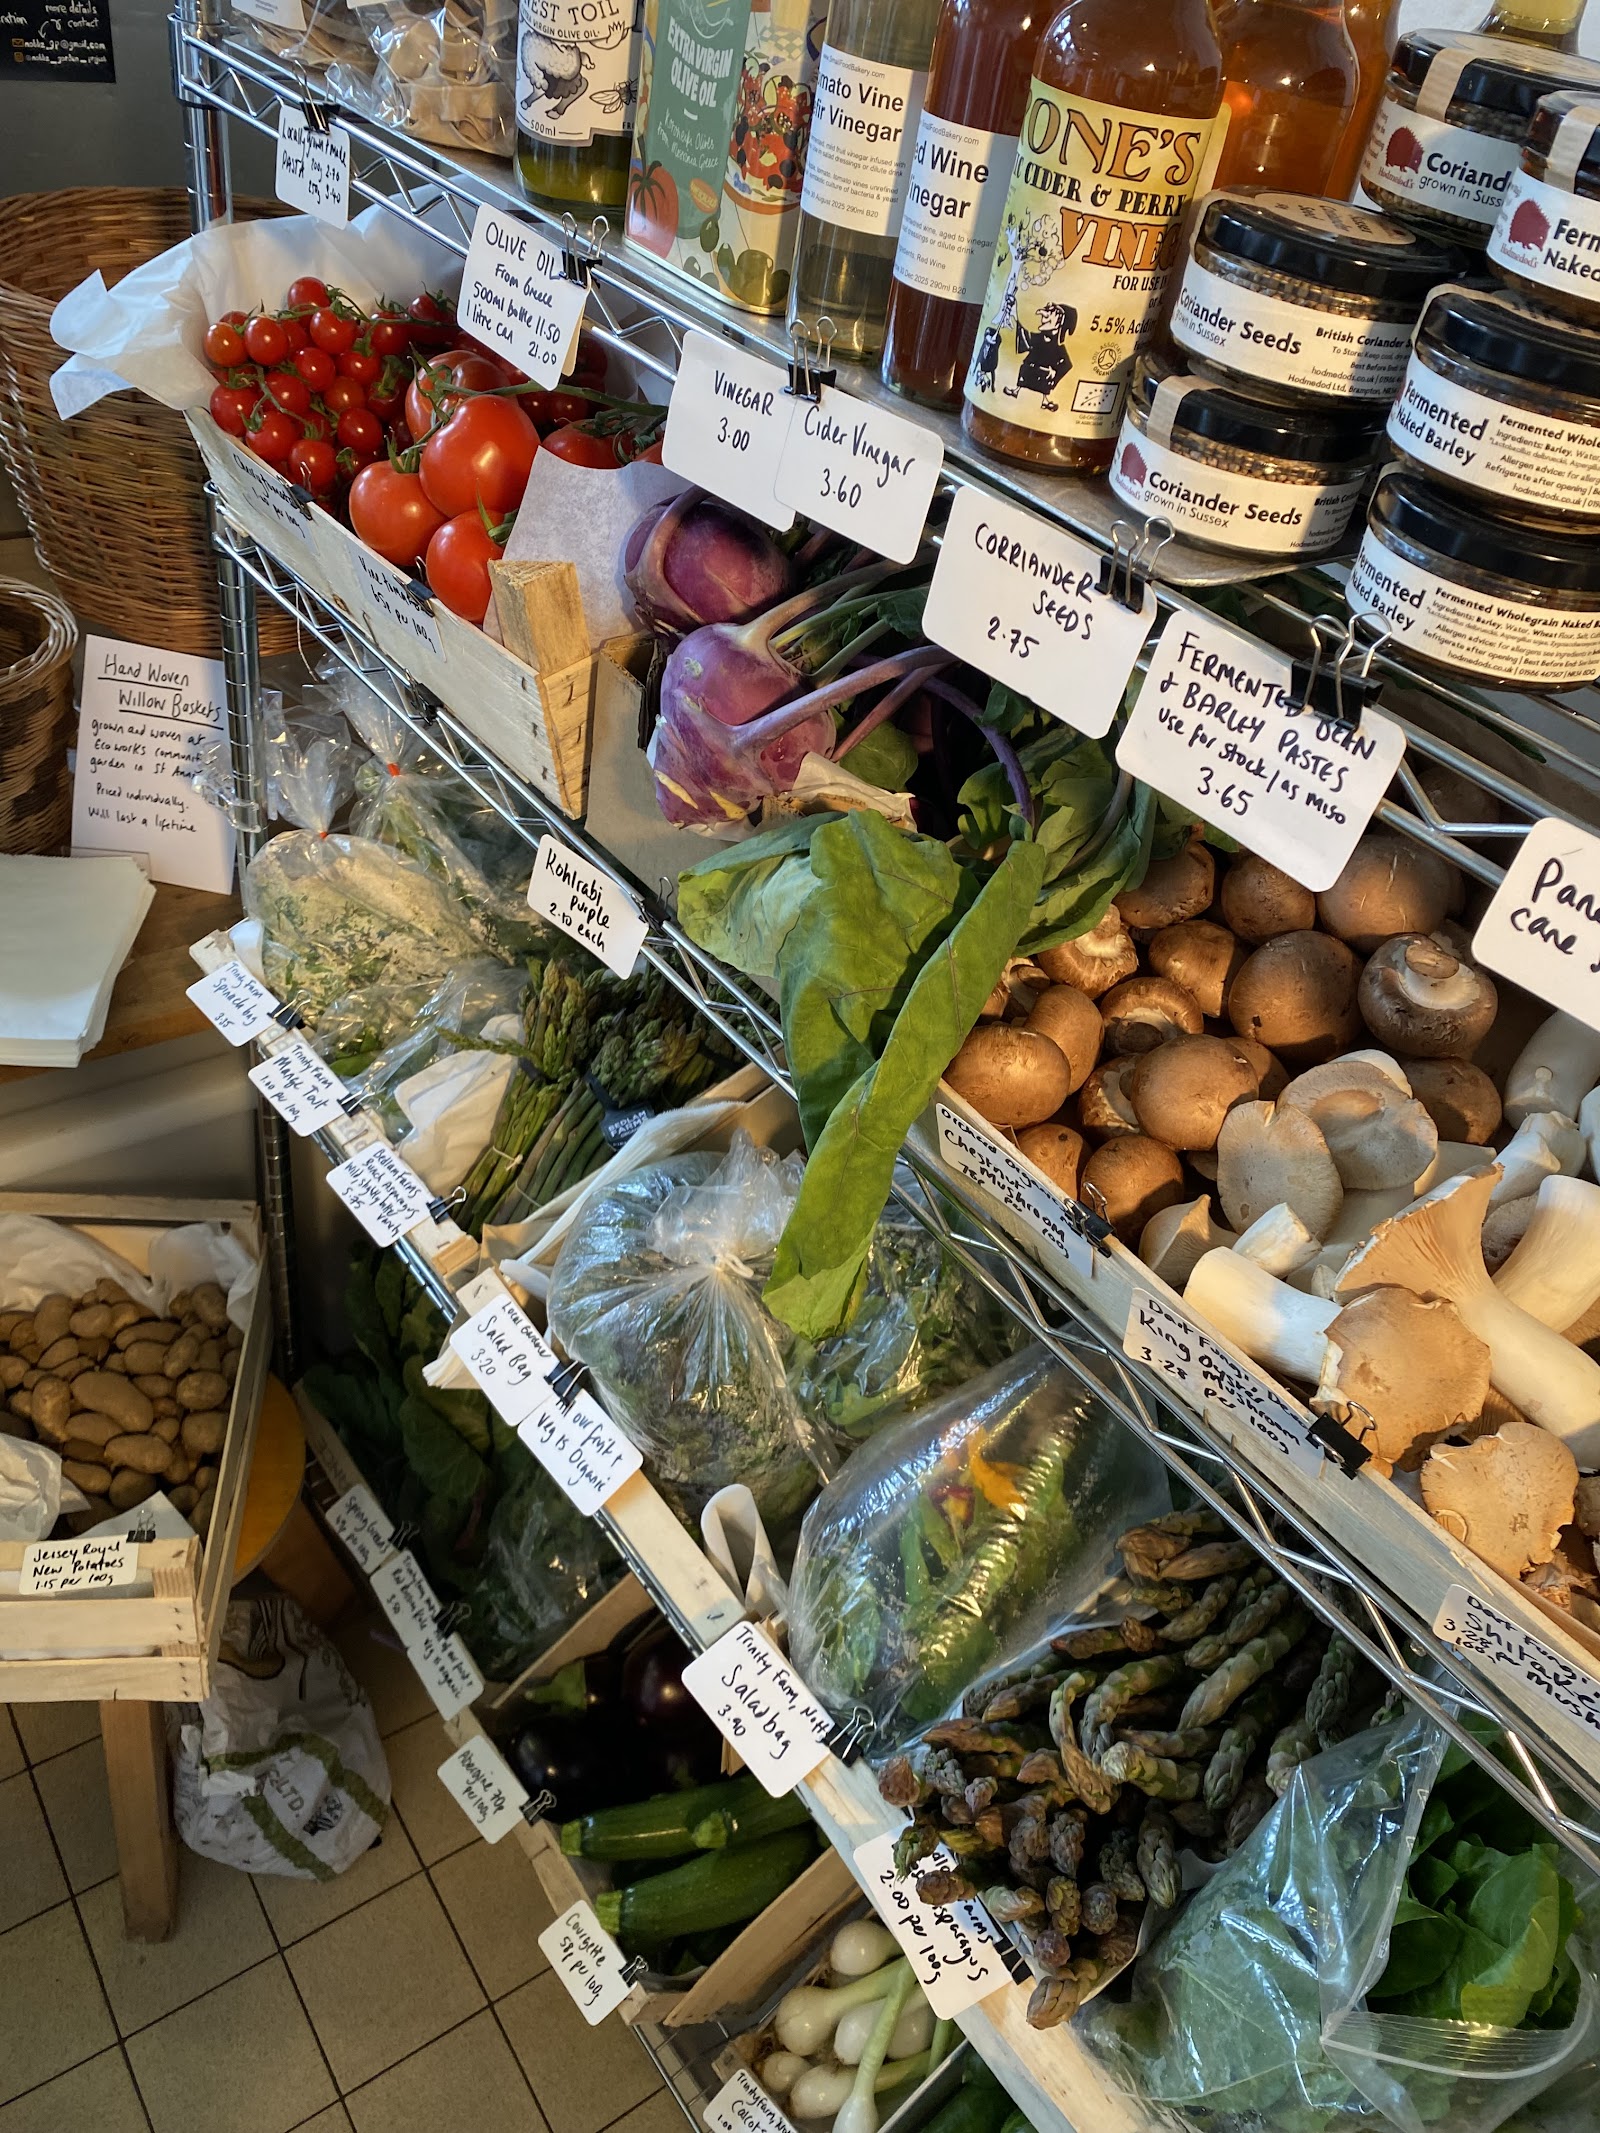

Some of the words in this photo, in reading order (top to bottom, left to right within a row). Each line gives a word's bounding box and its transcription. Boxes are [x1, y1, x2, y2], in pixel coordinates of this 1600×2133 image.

[67, 17, 99, 28] contact
[69, 0, 97, 14] details
[568, 0, 619, 25] TOIL
[557, 29, 580, 39] OLIVE
[667, 15, 695, 66] EXTRA
[695, 44, 733, 79] VIRGIN
[671, 57, 699, 101] OLIVE
[699, 80, 717, 107] OIL
[859, 83, 904, 112] Vine
[530, 119, 556, 136] 500ml
[830, 105, 902, 142] Vinegar
[282, 150, 304, 178] PASTA
[931, 144, 989, 184] Wine
[909, 181, 971, 218] inegar
[1024, 161, 1082, 203] CIDER
[1090, 184, 1112, 207] &
[1419, 175, 1456, 195] grown
[1459, 187, 1470, 199] in
[485, 222, 527, 261] OLIVE
[536, 250, 562, 280] OIL
[967, 237, 993, 248] vinegar
[1060, 206, 1182, 272] VINEG
[495, 264, 519, 289] From
[1112, 275, 1139, 291] FOR
[1141, 277, 1159, 291] USE
[473, 281, 504, 311] 500ml
[507, 299, 532, 328] bottle
[535, 315, 561, 344] 11.50
[1090, 315, 1125, 334] 5.5%
[1180, 287, 1236, 333] Coriander
[1240, 321, 1302, 354] Seeds
[472, 303, 492, 331] litre
[496, 322, 513, 344] can
[527, 341, 557, 365] 21.00
[1196, 323, 1227, 347] Sussex
[1316, 327, 1354, 344] British
[1357, 335, 1404, 348] Coriander
[713, 370, 774, 416] VINEGAR
[1288, 374, 1332, 391] Hodmedod
[1404, 379, 1489, 440] Fermented
[1500, 414, 1564, 440] Fermented
[718, 417, 750, 451] 3.00
[804, 405, 847, 446] Cider
[853, 422, 915, 488] Vinegar
[1396, 405, 1426, 438] Naked
[1425, 427, 1477, 466] Barley
[1496, 429, 1543, 449] Ingredients:
[1485, 461, 1531, 481] Refrigerate
[1533, 477, 1554, 487] after
[1556, 483, 1587, 495] opening
[1500, 454, 1534, 469] Allergen
[1536, 466, 1566, 477] advice:
[820, 468, 861, 508] 3.60
[1150, 471, 1240, 516] Coriander
[1244, 504, 1303, 525] Seeds
[1513, 483, 1581, 505] hodmedods.co.uk
[1144, 490, 1174, 511] grown
[1176, 503, 1187, 515] in
[1189, 508, 1229, 528] Sussex
[975, 522, 1093, 603] CORRIANDER
[1033, 590, 1093, 640] SEEDS
[1371, 593, 1416, 631] Barley
[1433, 600, 1475, 620] Ingredients:
[1533, 630, 1557, 638] Wheat
[1436, 587, 1494, 613] Fermented
[1497, 607, 1559, 627] Wholegrain
[1561, 620, 1594, 629] Naked
[987, 616, 1040, 658] 2.75
[1423, 629, 1464, 649] Refrigerate
[1466, 646, 1486, 656] after
[1488, 653, 1518, 664] opening
[1436, 624, 1467, 638] Allergen
[1468, 635, 1496, 647] advice:
[104, 654, 141, 677] Hand
[148, 663, 189, 686] Woven
[119, 689, 165, 710] Willow
[171, 693, 221, 722] Baskets
[91, 719, 123, 736] grown
[128, 724, 145, 736] and
[150, 729, 181, 742] woven
[1158, 707, 1185, 735] use
[1188, 728, 1217, 748] for
[1182, 682, 1266, 743] BARLEY
[1278, 729, 1350, 792] PASTES
[90, 757, 125, 774] garden
[97, 782, 122, 797] Priced
[126, 789, 189, 813] individually.
[1197, 767, 1253, 816] 3.65
[88, 807, 109, 818] Will
[117, 810, 136, 823] last
[155, 814, 196, 832] lifetime
[545, 848, 602, 906] Kohlrabi
[549, 903, 572, 927] 2.10
[577, 923, 605, 952] each
[570, 896, 610, 929] purple
[213, 977, 249, 1009] Spinach
[242, 1004, 257, 1026] bag
[273, 1056, 304, 1089] Mange
[303, 1085, 329, 1109] Tout
[608, 1110, 647, 1130] BEDLAM
[944, 1129, 1026, 1190] Chestnut
[1149, 1299, 1194, 1334] Dark
[477, 1316, 511, 1356] Salad
[507, 1353, 532, 1385] Bag
[1139, 1309, 1191, 1362] King
[471, 1348, 496, 1376] 3.20
[1203, 1370, 1300, 1446] Mushroom
[537, 1412, 557, 1443] Veg
[568, 1448, 611, 1493] Organic
[572, 1413, 594, 1430] our
[585, 1423, 616, 1456] fruit
[1251, 1416, 1290, 1455] 100g
[33, 1548, 79, 1565] Jersey
[83, 1541, 120, 1559] Royal
[33, 1565, 62, 1578] New
[72, 1557, 125, 1574] Potatoes
[35, 1579, 54, 1590] 1.15
[60, 1577, 82, 1589] per
[88, 1572, 113, 1586] 100g
[736, 1626, 772, 1676] Trinity
[772, 1669, 799, 1710] Farm,
[717, 1704, 746, 1736] 3.90
[722, 1664, 770, 1719] Salad
[763, 1712, 791, 1760] bag
[462, 1786, 477, 1799] per
[473, 1797, 489, 1823] 100g
[880, 1870, 910, 1910] 2.00
[898, 1915, 927, 1937] per
[919, 1945, 941, 1985] 100g
[584, 1975, 603, 2006] 100g
[737, 2072, 760, 2106] Trinity
